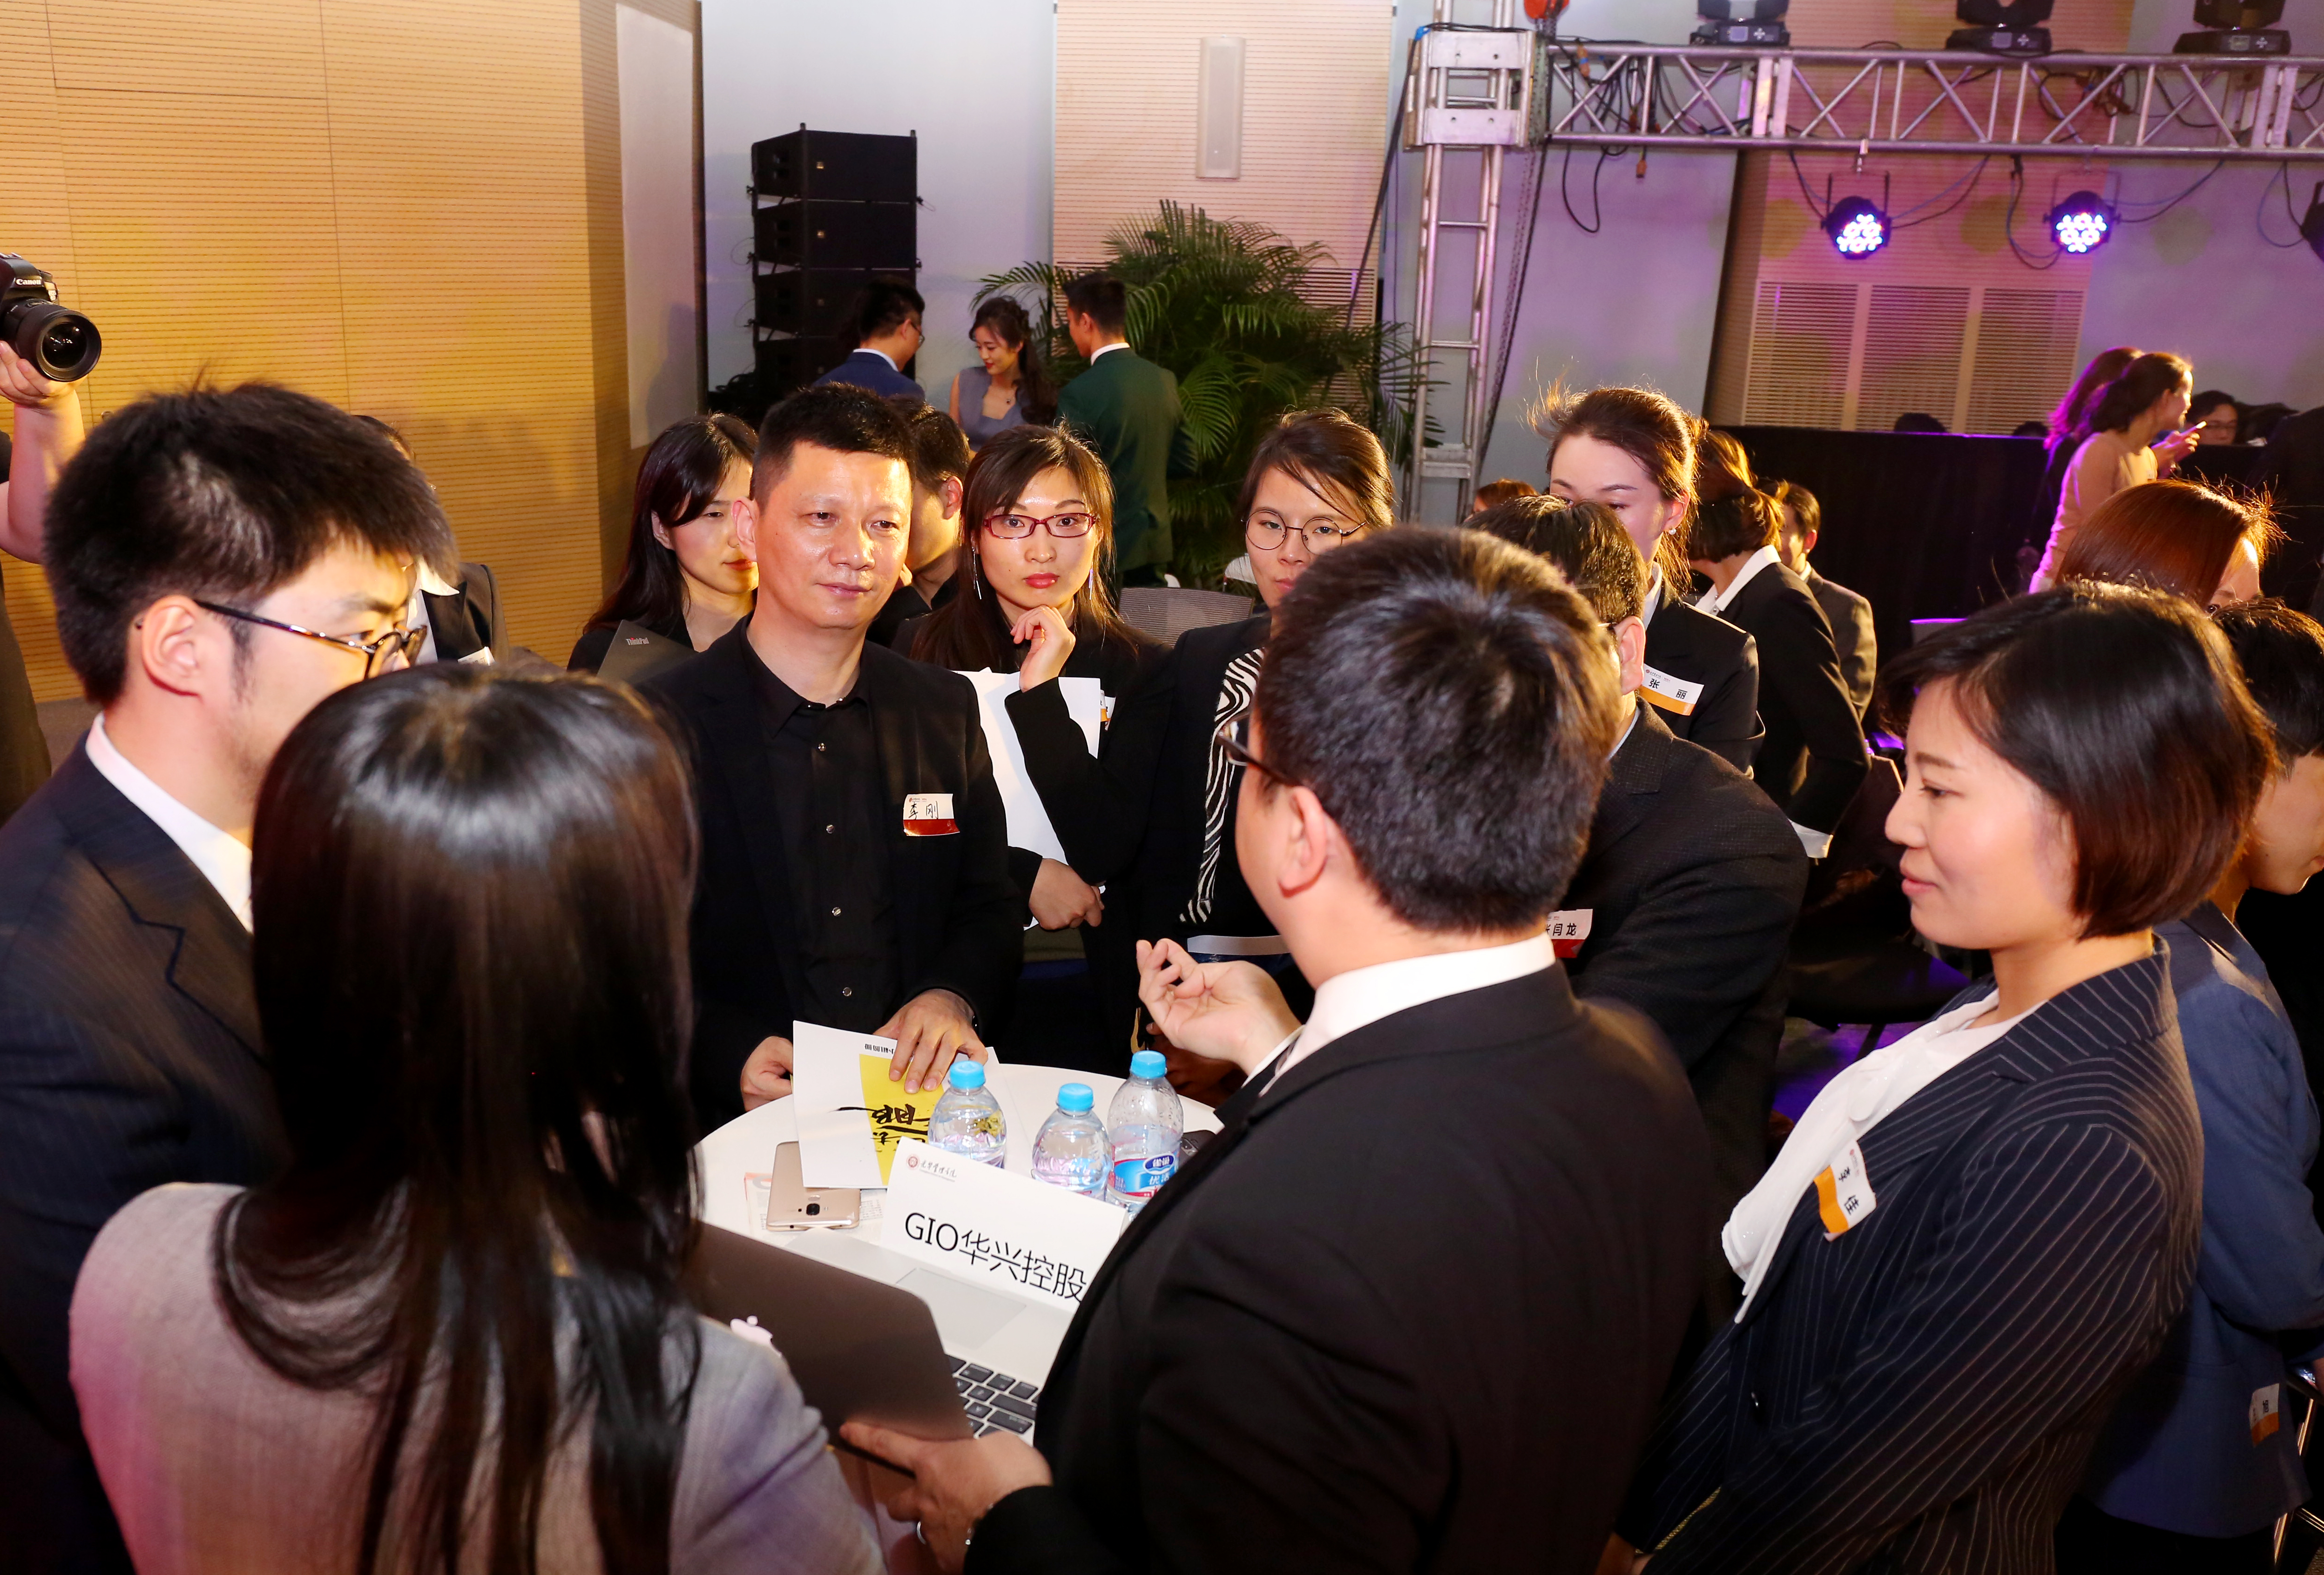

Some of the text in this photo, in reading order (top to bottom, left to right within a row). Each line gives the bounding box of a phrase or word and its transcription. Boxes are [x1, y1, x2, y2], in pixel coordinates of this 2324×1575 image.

[625, 637, 649, 646] ThinkPad
[1648, 678, 1688, 700] 张丽
[908, 801, 939, 820] 李刚
[905, 1212, 1087, 1304] GIO华兴控股
